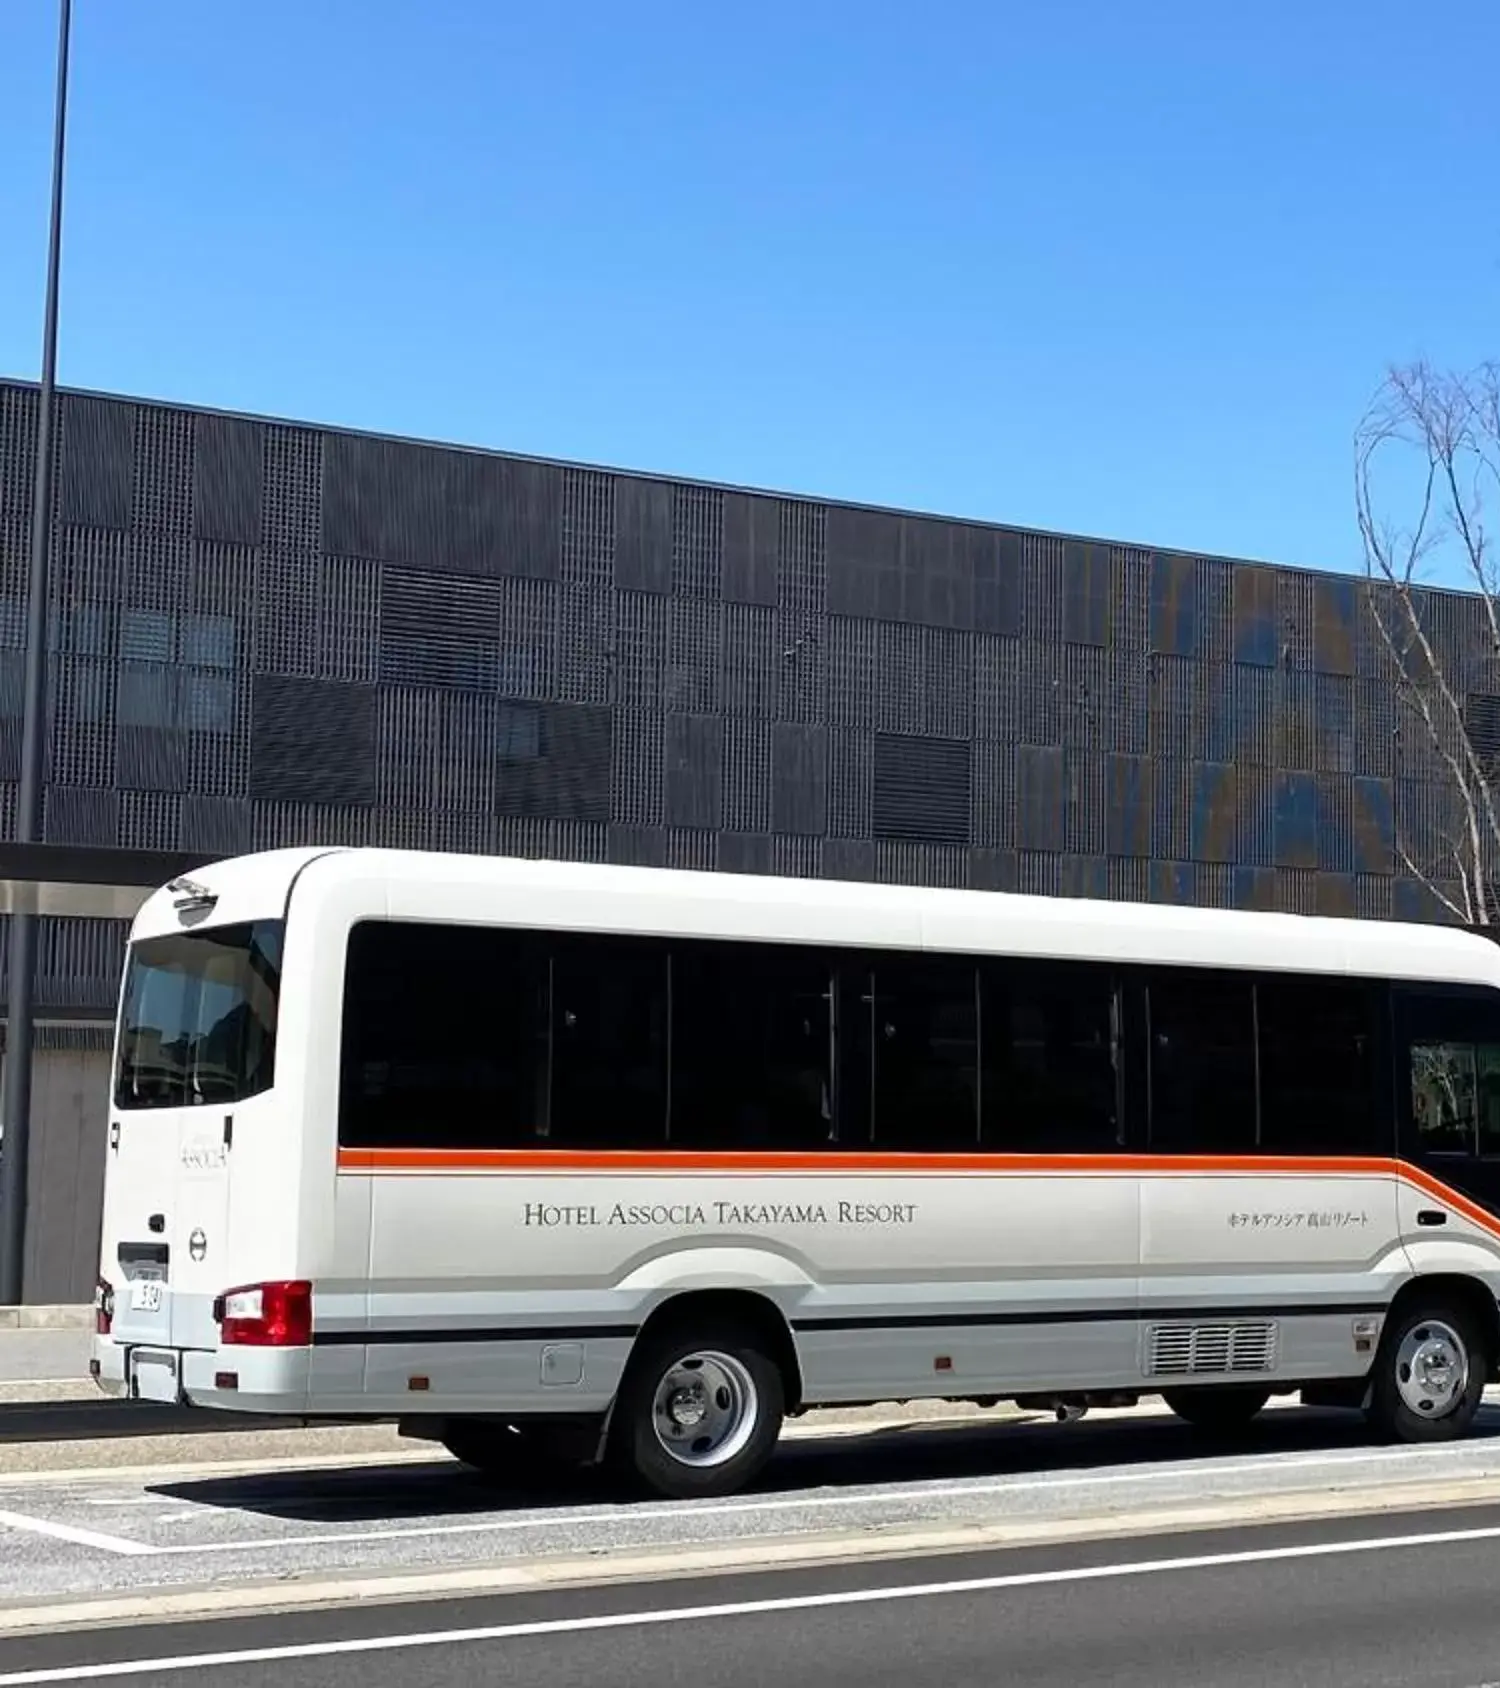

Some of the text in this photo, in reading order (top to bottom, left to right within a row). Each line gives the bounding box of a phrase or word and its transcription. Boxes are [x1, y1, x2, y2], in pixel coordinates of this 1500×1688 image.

[524, 1201, 919, 1226] HOTEL ASSOCIA TAKAYAMA RESORT
